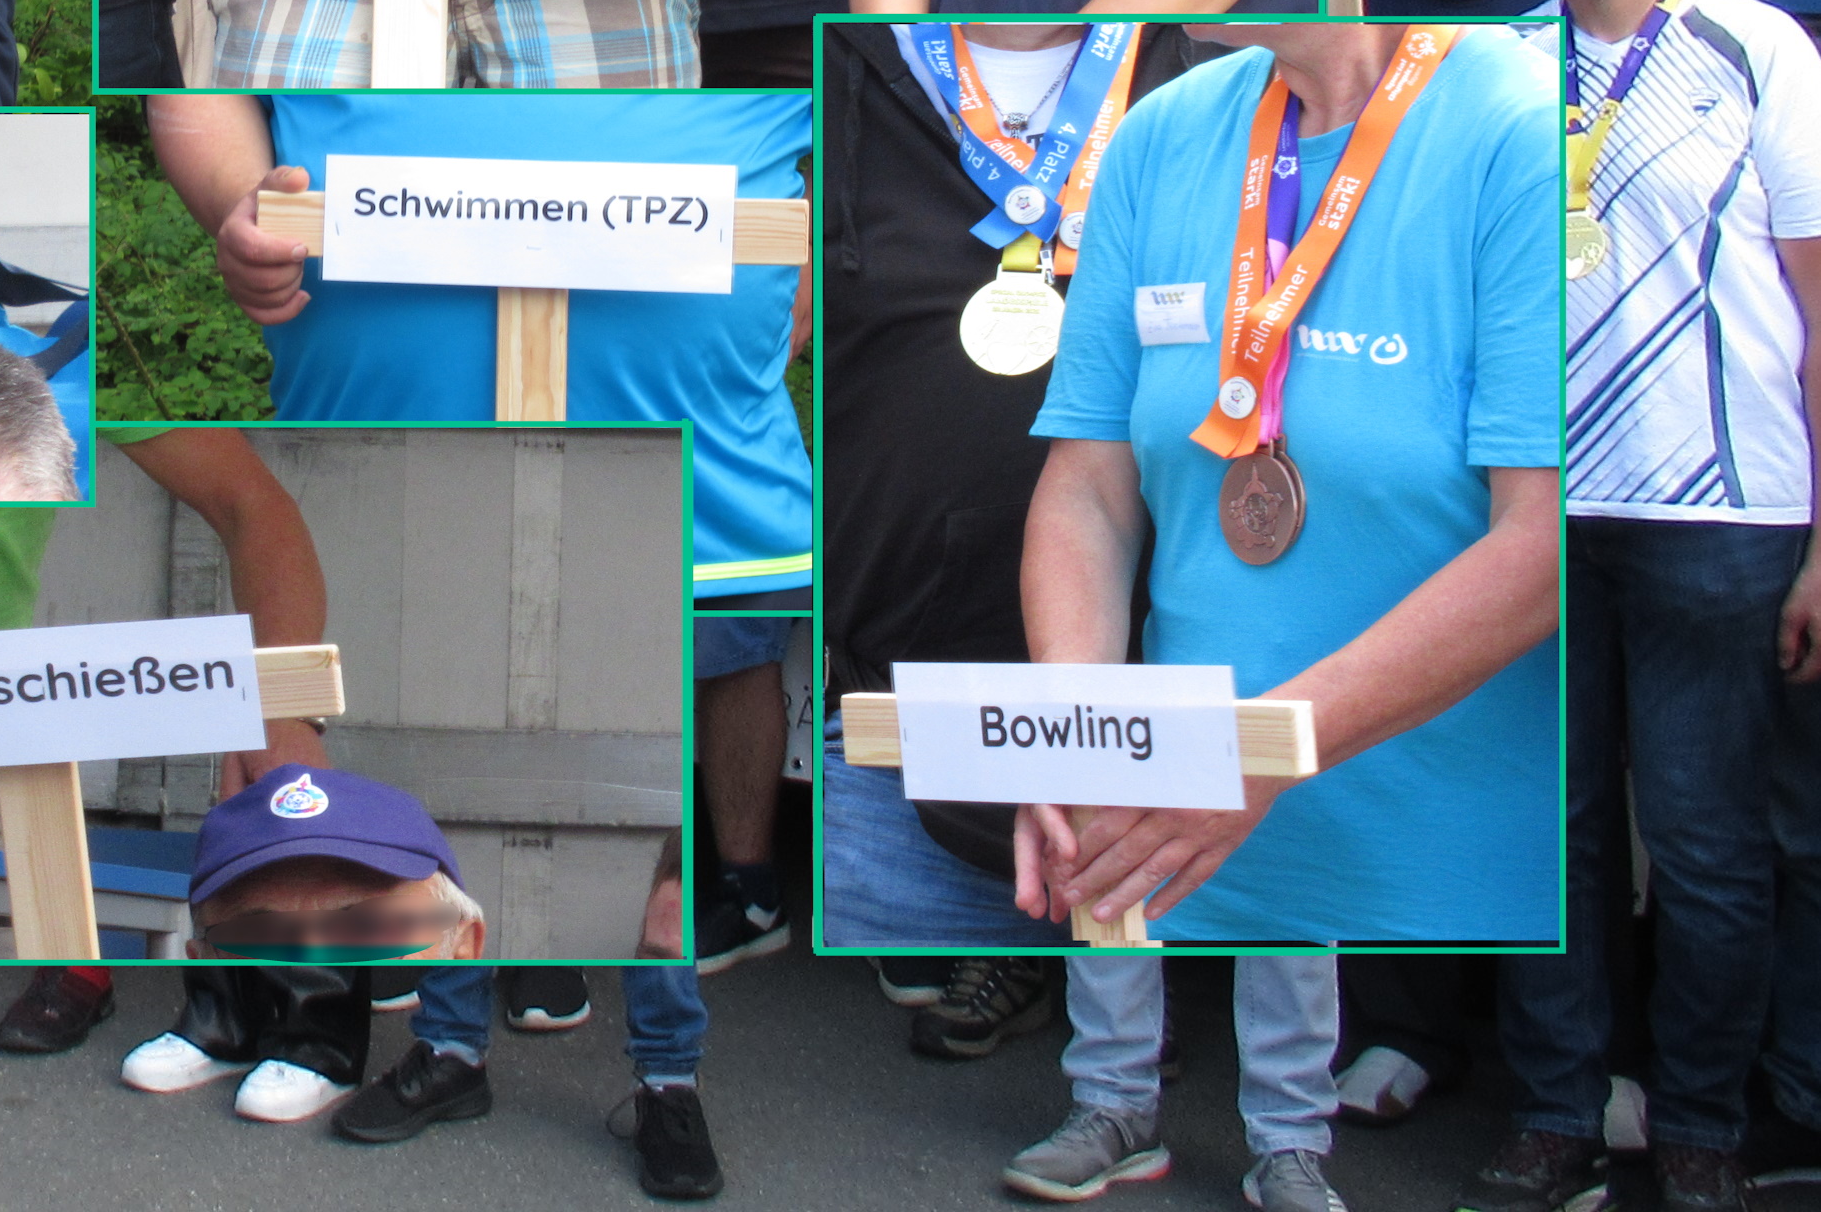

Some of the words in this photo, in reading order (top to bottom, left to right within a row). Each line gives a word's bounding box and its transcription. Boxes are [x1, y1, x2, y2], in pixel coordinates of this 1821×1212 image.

[930, 40, 955, 80] stark!
[1058, 122, 1076, 134] 4.
[1035, 140, 1069, 183] Platz
[1244, 158, 1260, 210] stark!
[353, 187, 588, 222] Schwimmen
[602, 195, 709, 232] (TPZ)
[1318, 175, 1347, 226] Gemeinsam
[1328, 177, 1361, 230] stark!
[1244, 264, 1308, 362] Teilnehmer
[980, 704, 1153, 761] Bowling
